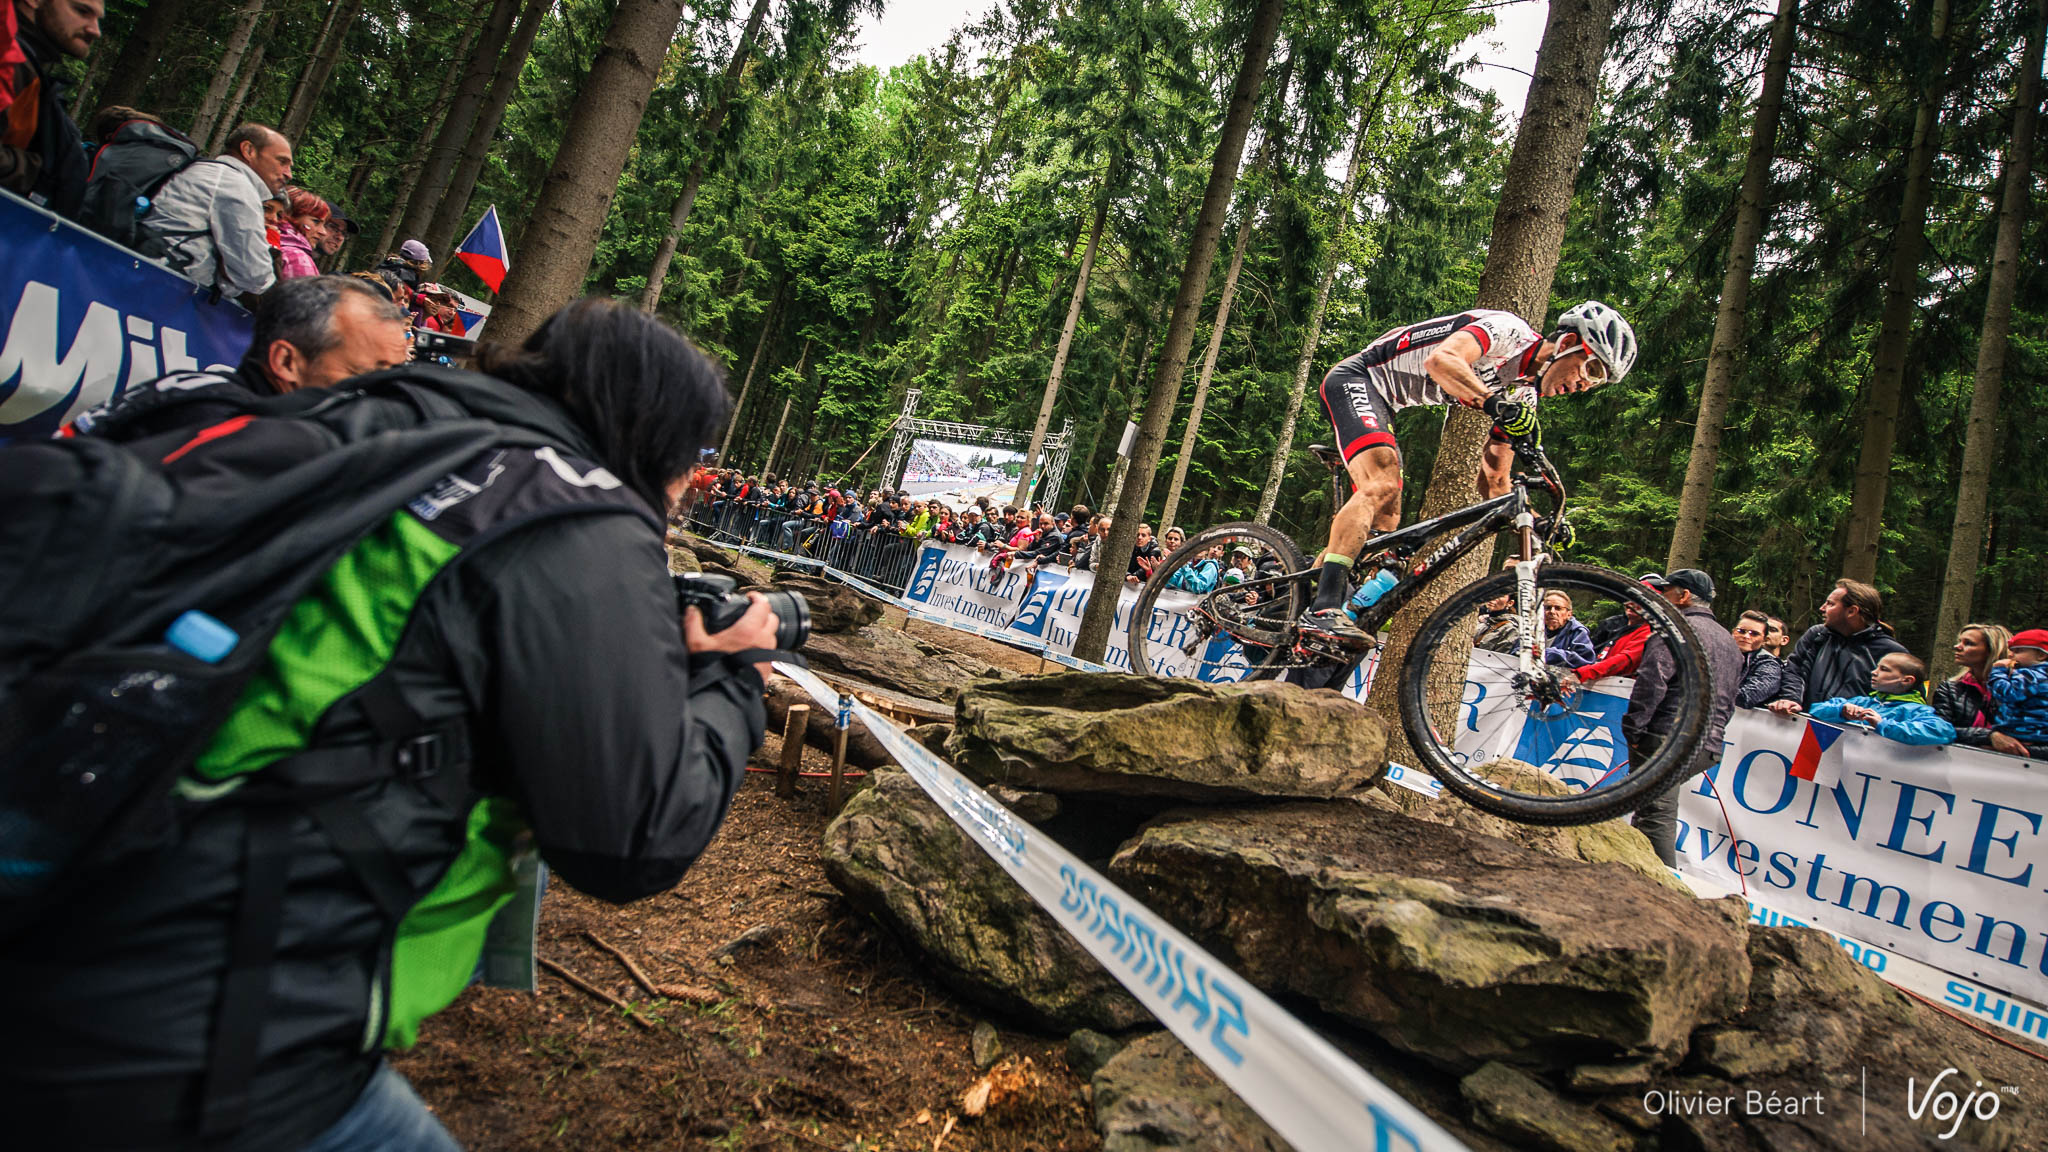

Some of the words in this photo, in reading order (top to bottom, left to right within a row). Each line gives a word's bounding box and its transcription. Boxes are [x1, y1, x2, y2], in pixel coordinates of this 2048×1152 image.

[0, 280, 237, 427] Mit
[1347, 382, 1378, 420] FRM
[1425, 536, 1461, 568] FRM
[928, 587, 1007, 630] Investments
